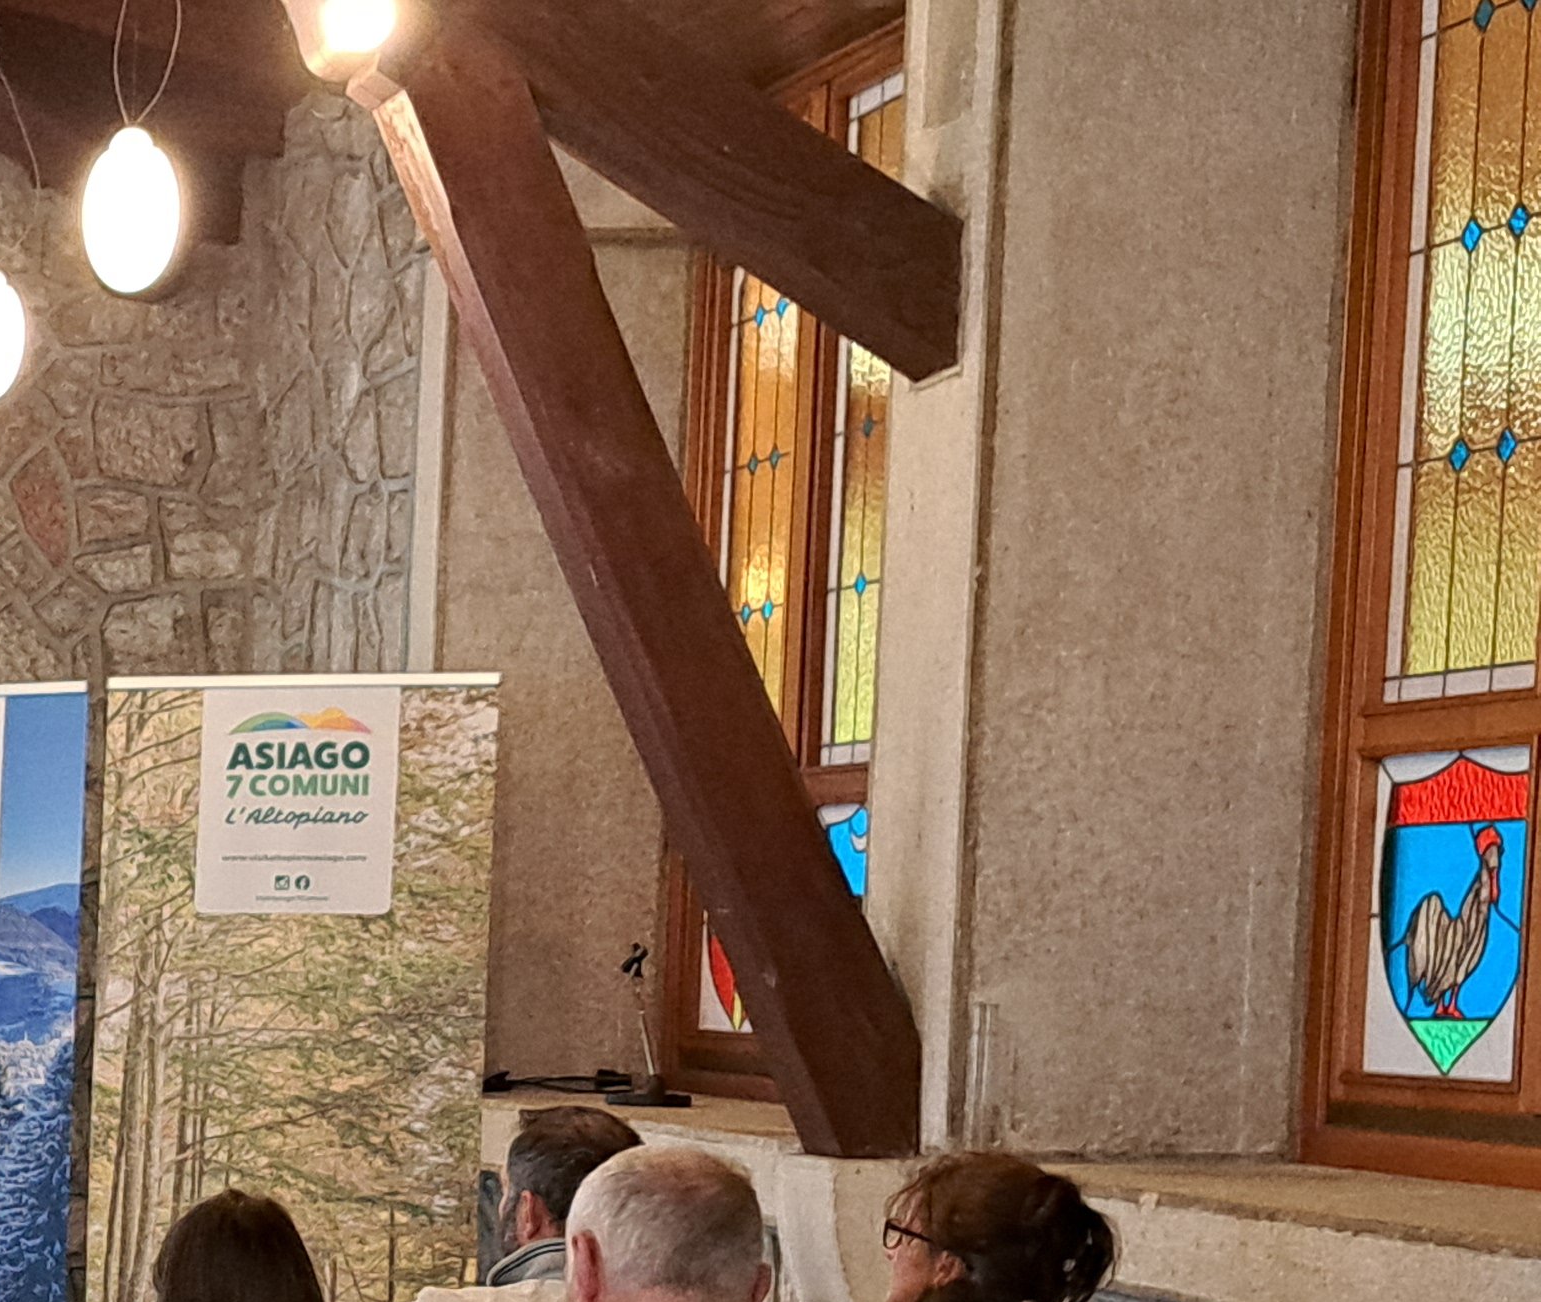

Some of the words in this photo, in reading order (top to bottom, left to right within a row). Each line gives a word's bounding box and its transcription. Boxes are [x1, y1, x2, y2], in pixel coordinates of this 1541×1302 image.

[226, 741, 370, 770] ASIAGO
[226, 774, 244, 799] 7
[249, 773, 370, 797] COMUNI
[225, 806, 369, 830] L'Altopiano
